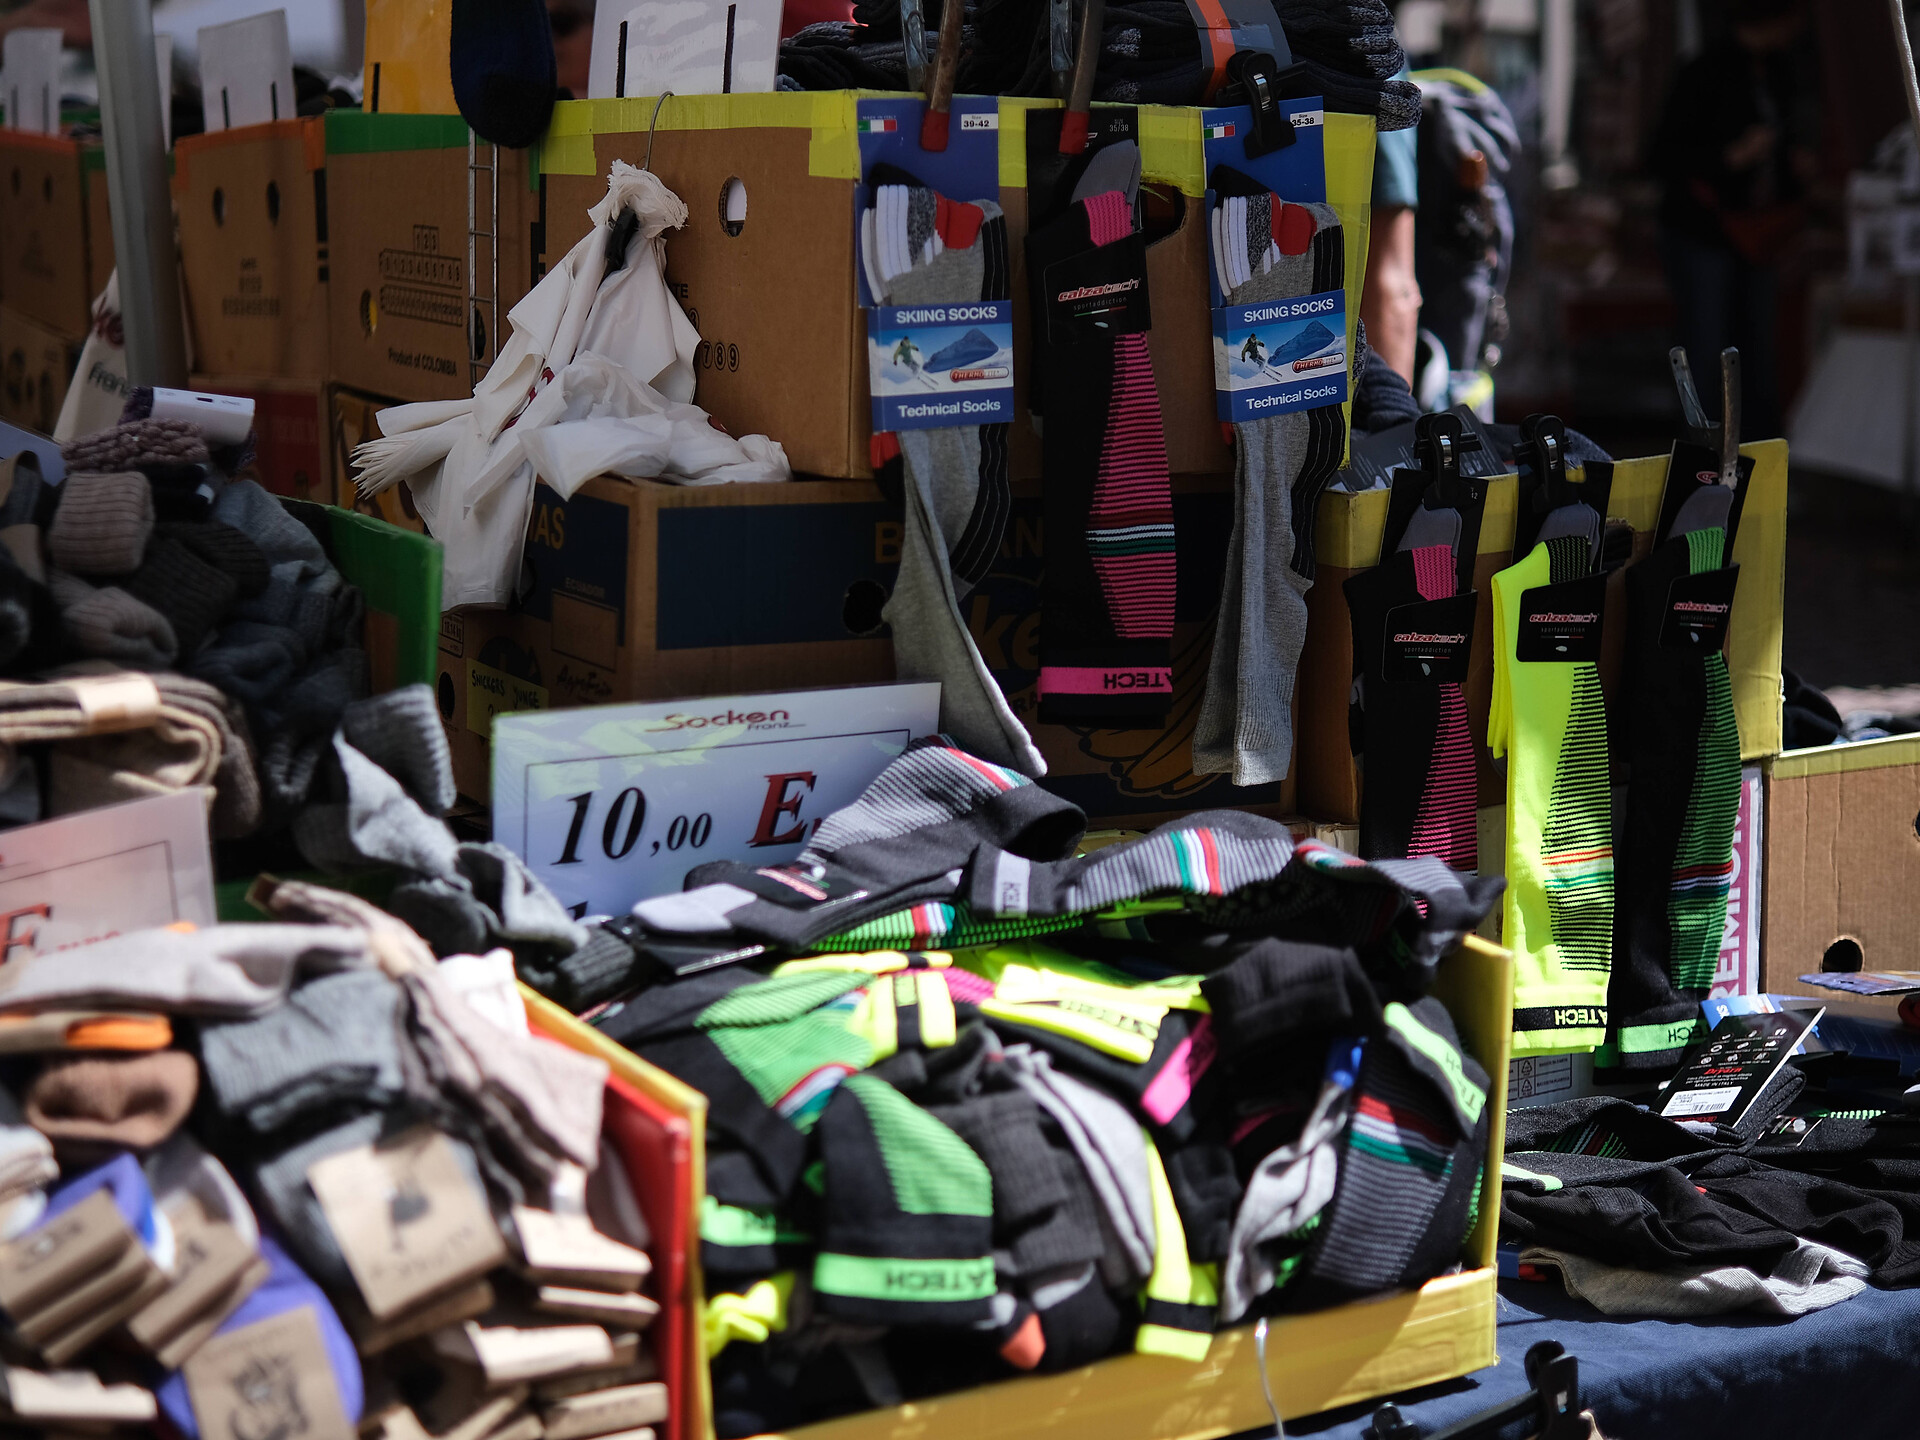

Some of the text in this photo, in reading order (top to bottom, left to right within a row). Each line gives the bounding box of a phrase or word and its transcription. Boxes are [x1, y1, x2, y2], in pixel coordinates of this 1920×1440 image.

[963, 120, 990, 128] 39-42
[1109, 123, 1129, 132] 35/38
[1291, 117, 1315, 127] 35-38
[1057, 278, 1140, 303] calzatech
[895, 305, 998, 325] SKIING SOCKS
[1243, 298, 1335, 323] SKIING SOCKS
[1245, 385, 1338, 410] Technical Socks
[897, 398, 1002, 418] Technical Socks
[1529, 612, 1598, 623] calzatech
[1393, 632, 1466, 644] calzatech
[645, 709, 790, 732] Socken
[550, 786, 713, 866] 10,00
